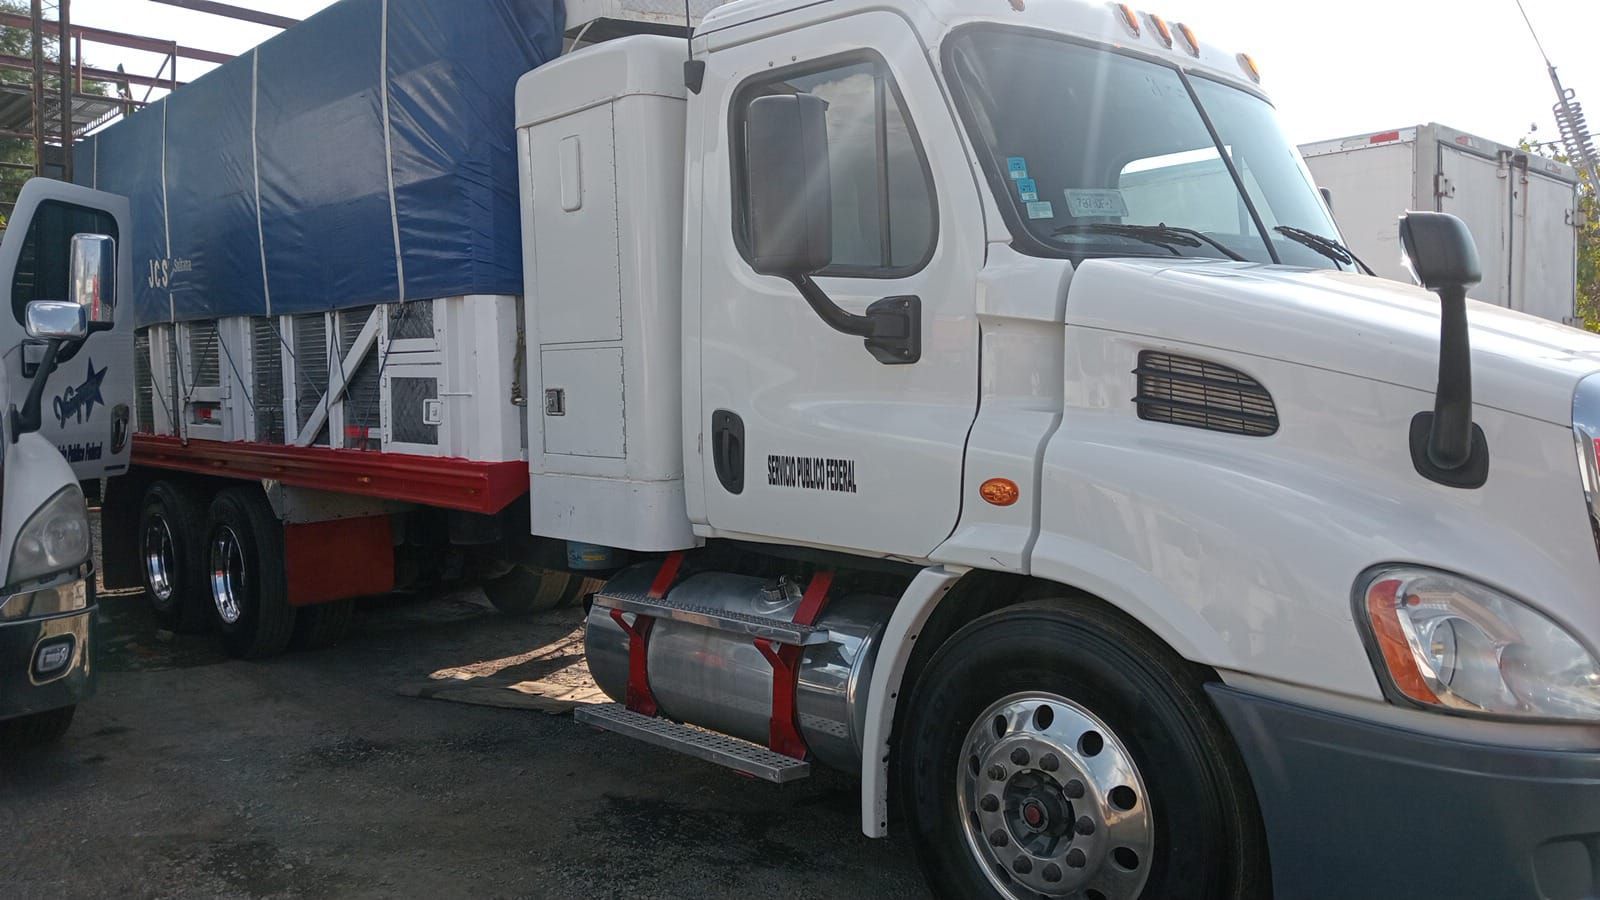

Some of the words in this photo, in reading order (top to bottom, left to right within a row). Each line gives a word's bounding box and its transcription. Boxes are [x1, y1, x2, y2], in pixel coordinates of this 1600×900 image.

[768, 454, 796, 487] SERVICIO
[797, 456, 825, 490] PUBLICO
[826, 458, 857, 493] FEDERAL
